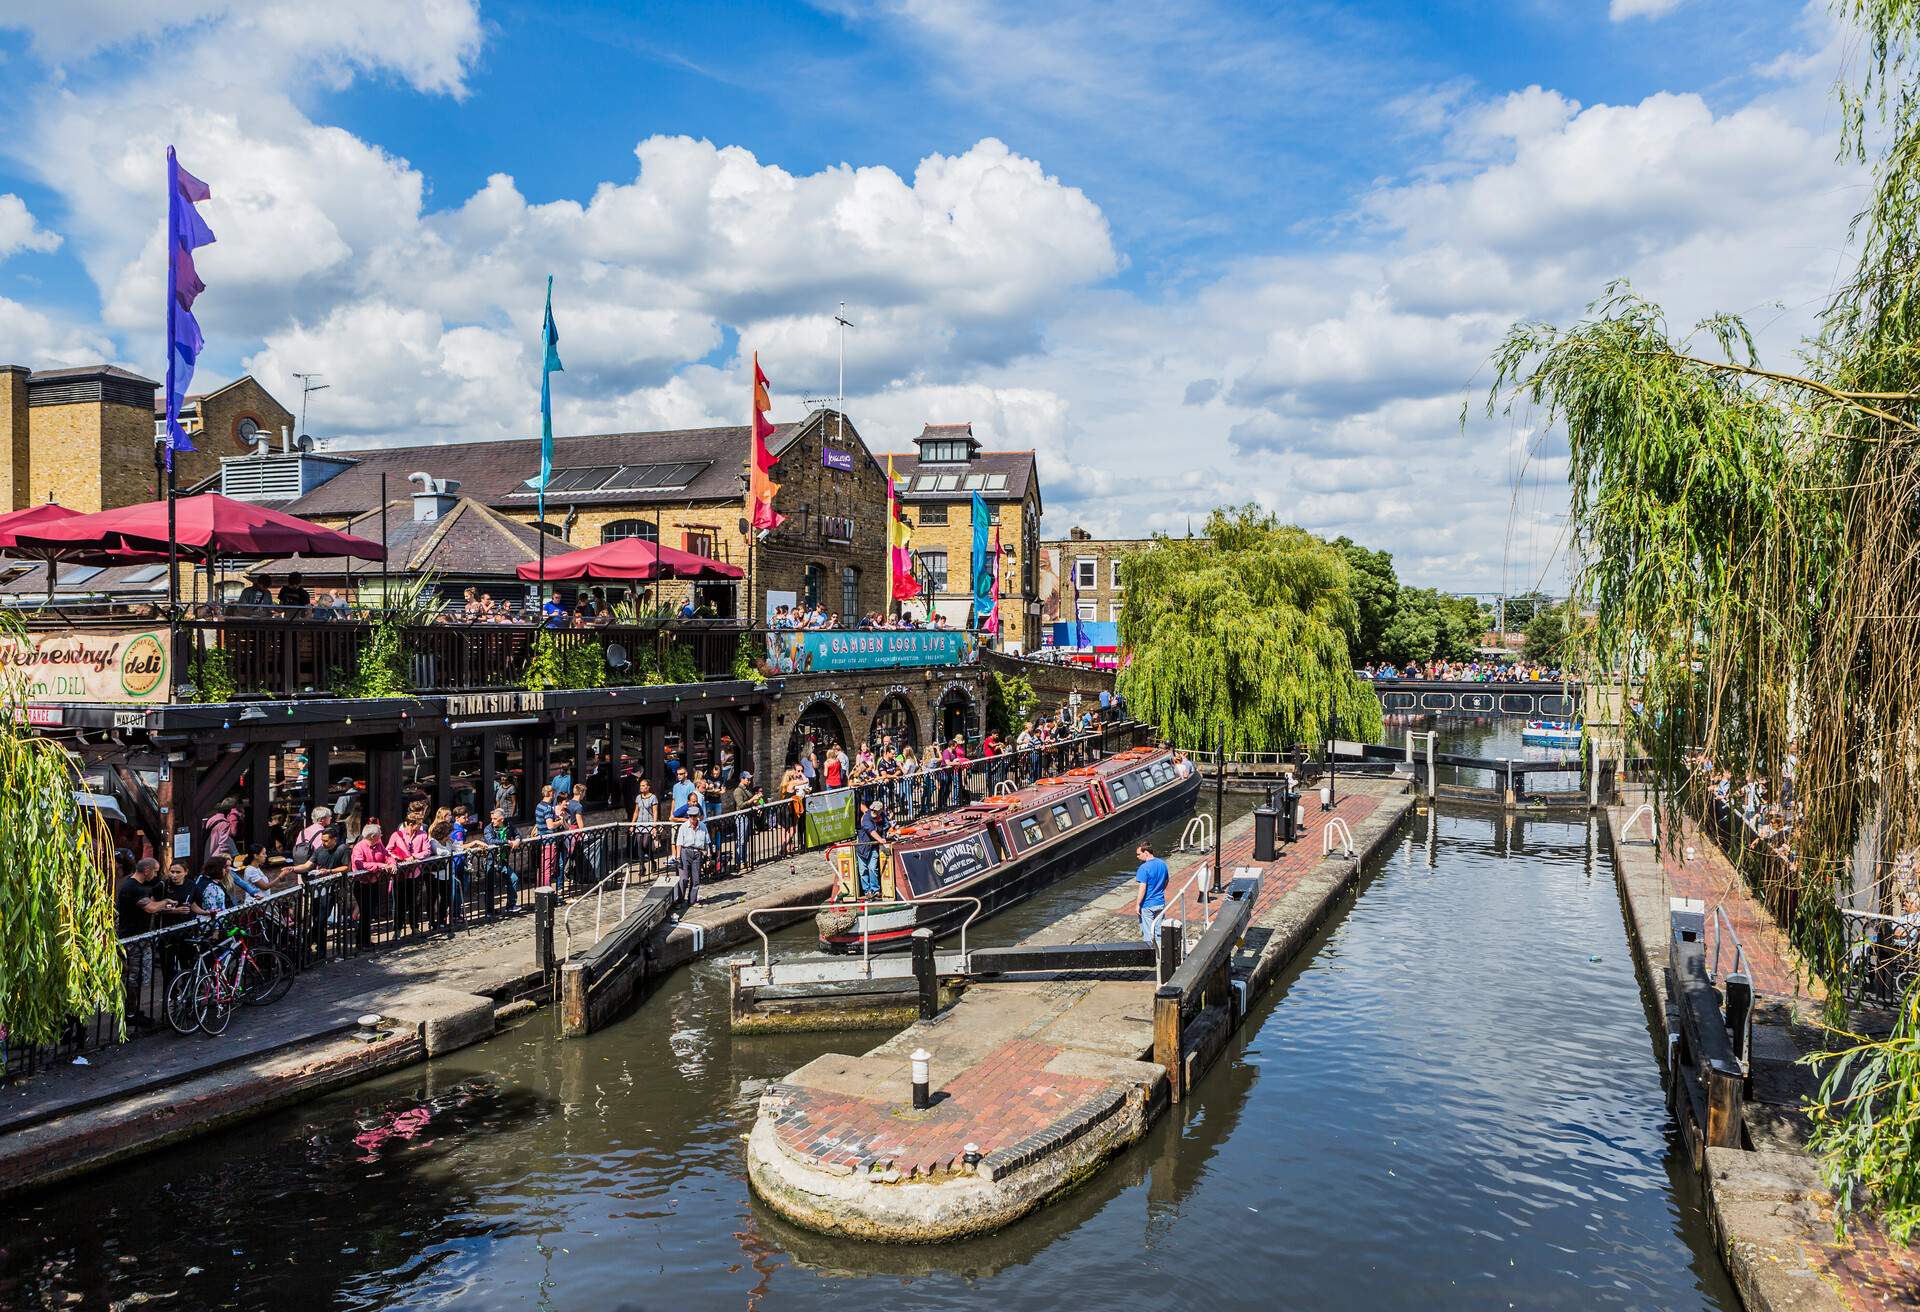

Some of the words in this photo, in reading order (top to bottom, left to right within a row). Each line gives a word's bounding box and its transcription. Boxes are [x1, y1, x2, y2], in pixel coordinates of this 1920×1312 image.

[832, 637, 883, 654] CAMDEN
[889, 637, 916, 652] LOCK
[922, 636, 945, 652] LIVE
[125, 656, 161, 674] deli
[448, 695, 515, 716] CANALSIDE
[521, 693, 544, 711] BAR
[799, 690, 845, 712] CAMDEN
[16, 710, 49, 721] ENRANCE
[116, 714, 130, 726] WAY
[130, 714, 144, 726] OUT
[941, 844, 975, 867] TARPORLEY
